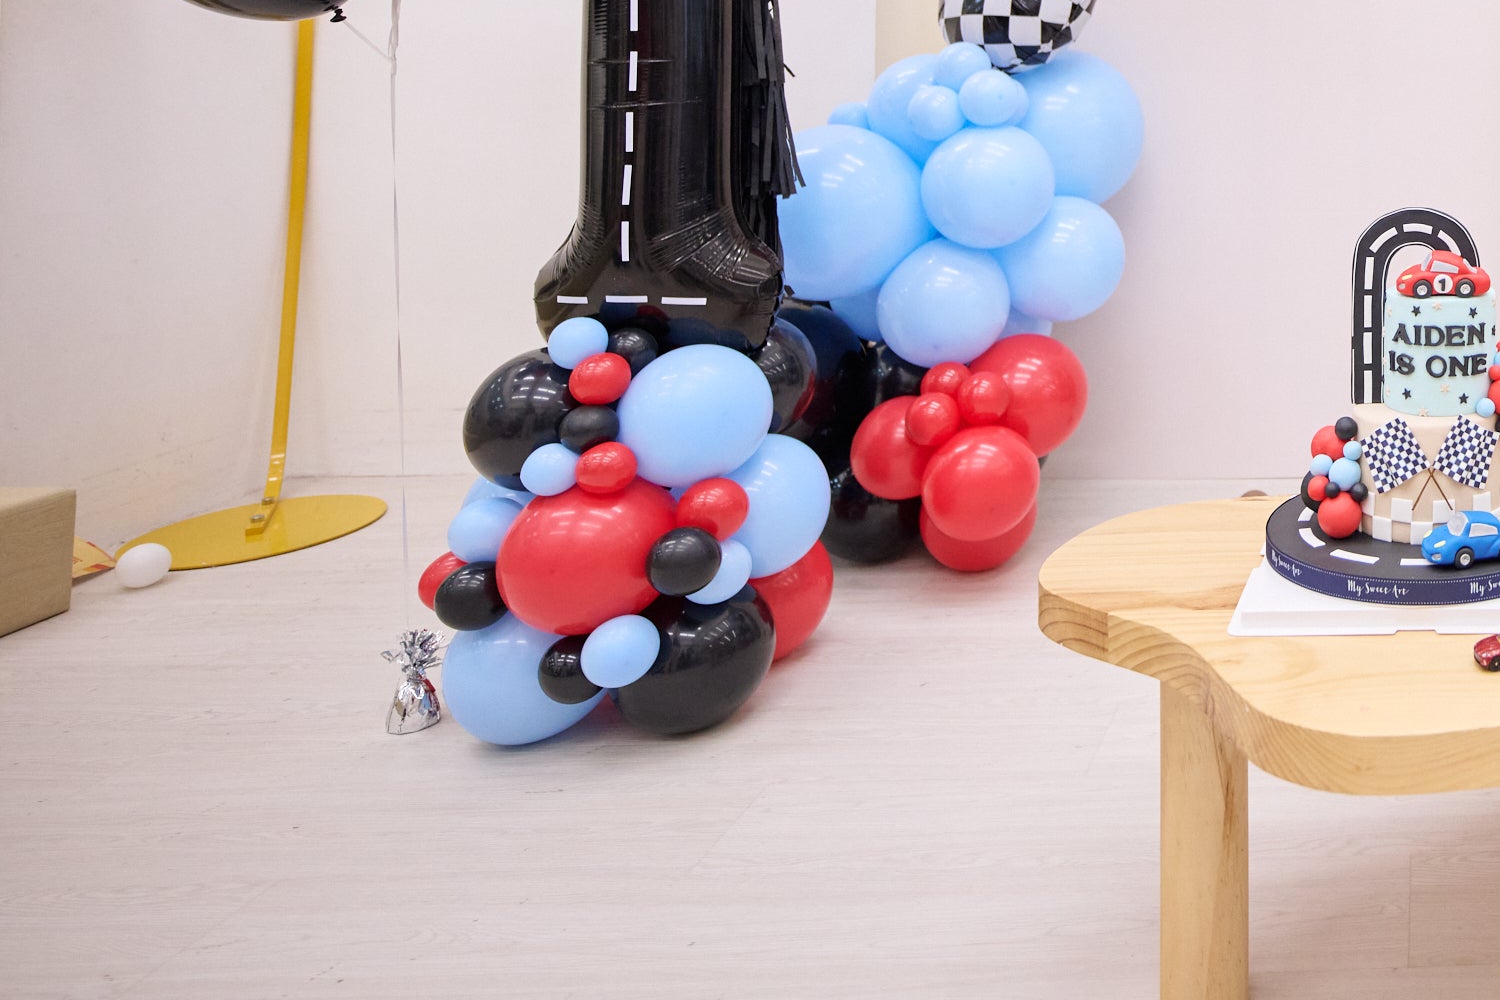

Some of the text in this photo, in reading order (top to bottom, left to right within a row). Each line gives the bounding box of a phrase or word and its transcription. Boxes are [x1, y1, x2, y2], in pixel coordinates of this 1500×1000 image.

[1438, 278, 1447, 292] 1
[1392, 322, 1486, 347] AIDEN
[1388, 350, 1488, 378] IS ONE
[1347, 580, 1409, 599] My Sweet Art
[1470, 582, 1487, 596] My
